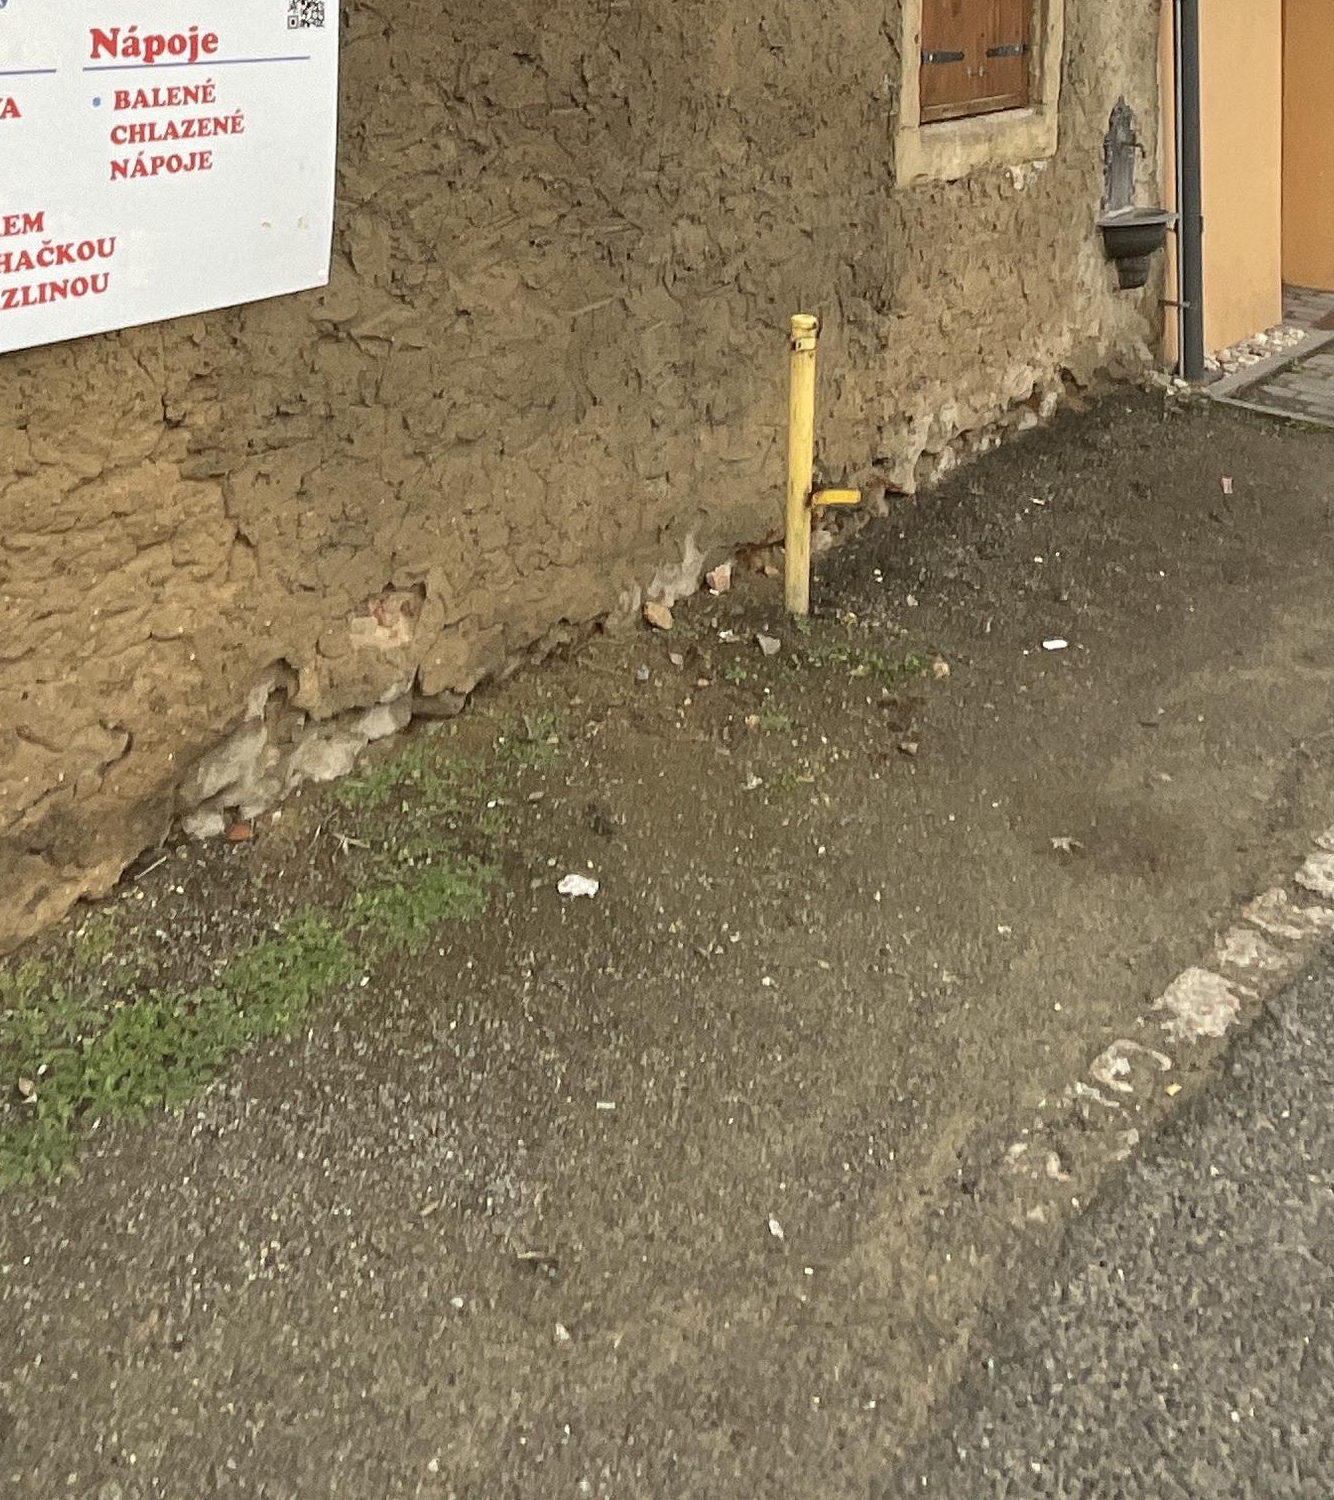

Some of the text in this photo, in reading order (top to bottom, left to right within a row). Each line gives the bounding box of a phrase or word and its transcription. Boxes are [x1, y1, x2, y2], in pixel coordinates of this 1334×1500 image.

[89, 25, 218, 63] Nápoje
[114, 79, 217, 112] BALENÉ
[110, 110, 245, 146] CHLAZENÉ
[110, 150, 213, 182] NÁPOJE
